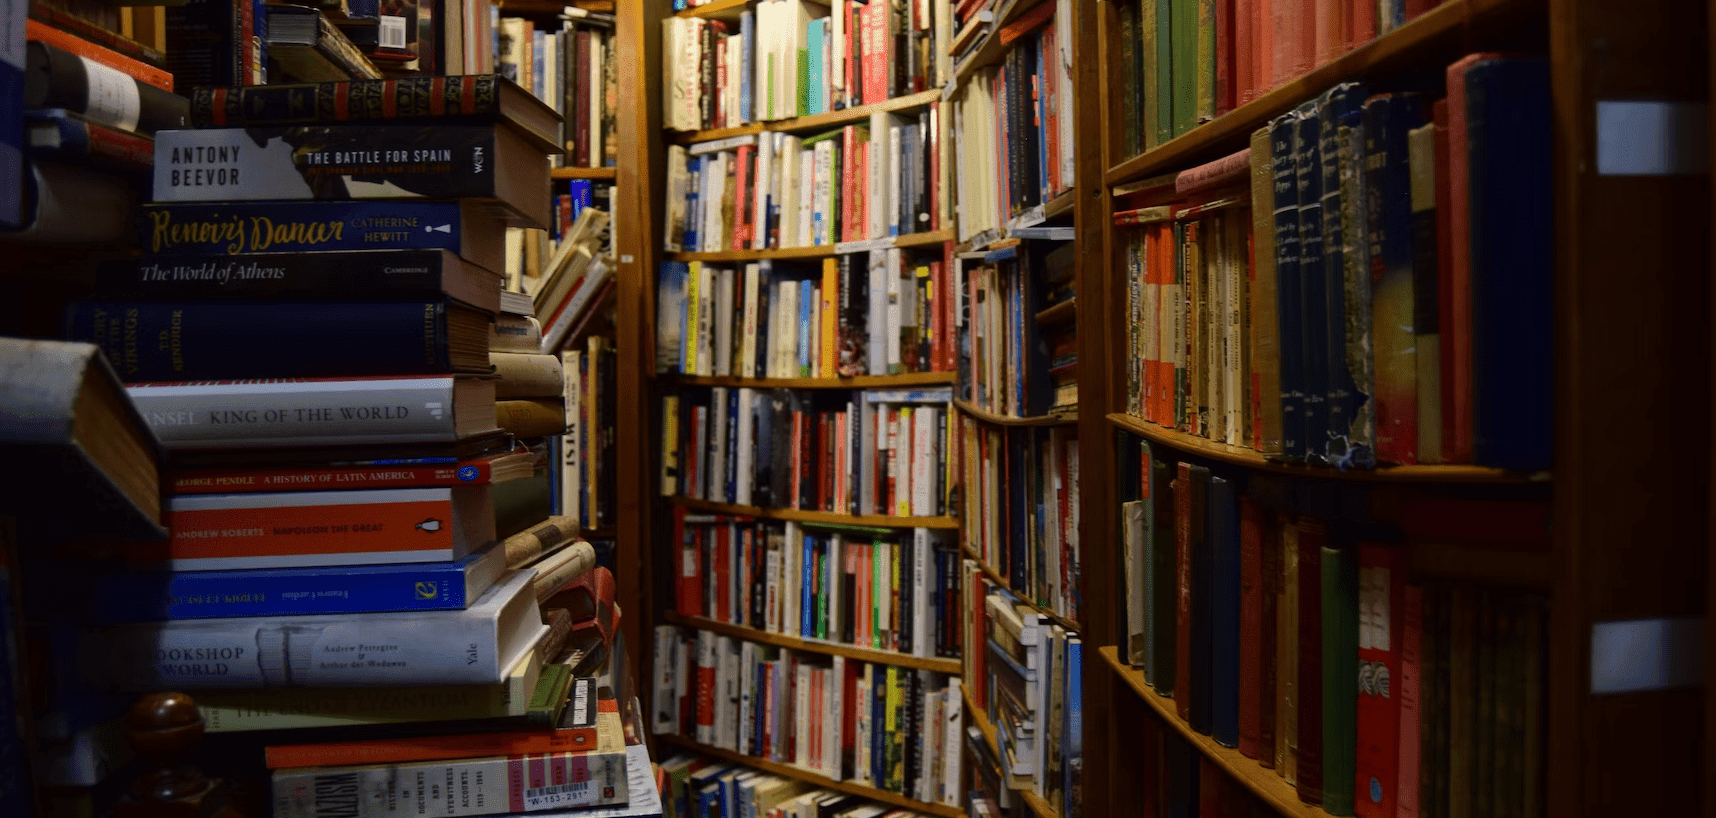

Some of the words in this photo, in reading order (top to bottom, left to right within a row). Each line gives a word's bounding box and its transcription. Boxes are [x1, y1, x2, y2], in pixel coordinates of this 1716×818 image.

[171, 145, 240, 164] ANTONY
[307, 151, 330, 165] THE
[335, 150, 381, 164] BATTLE
[385, 150, 408, 163] FOR
[413, 149, 452, 162] SPAIN
[171, 168, 240, 187] BEEVOR
[350, 217, 419, 229] CATHERINE
[150, 210, 246, 255] Renoir's
[250, 216, 344, 251] Dancer
[363, 231, 410, 243] HEWITT
[140, 262, 171, 281] The
[172, 262, 214, 281] World
[216, 261, 233, 284] of
[235, 262, 286, 280] Athens
[124, 308, 139, 374] VIKINGS
[142, 411, 196, 426] ANSEL
[209, 410, 257, 425] KING
[264, 409, 289, 423] OF
[299, 408, 334, 422] THE
[340, 405, 410, 421] WORLD
[216, 476, 256, 486] PENDLE
[263, 475, 271, 484] A
[273, 473, 318, 484] HISTORY
[319, 473, 333, 483] OF
[336, 472, 367, 482] LATIN
[368, 471, 416, 481] AMERICA
[175, 529, 219, 540] ANDREW
[220, 528, 265, 539] ROBERTS
[158, 647, 245, 662] OOKSHOP
[324, 644, 356, 653] Andrew
[467, 643, 478, 665] Yale
[163, 662, 229, 676] WORLD
[417, 771, 425, 814] DOCUMENTS
[432, 784, 440, 800] AND
[446, 767, 455, 814] EYEWITNESS
